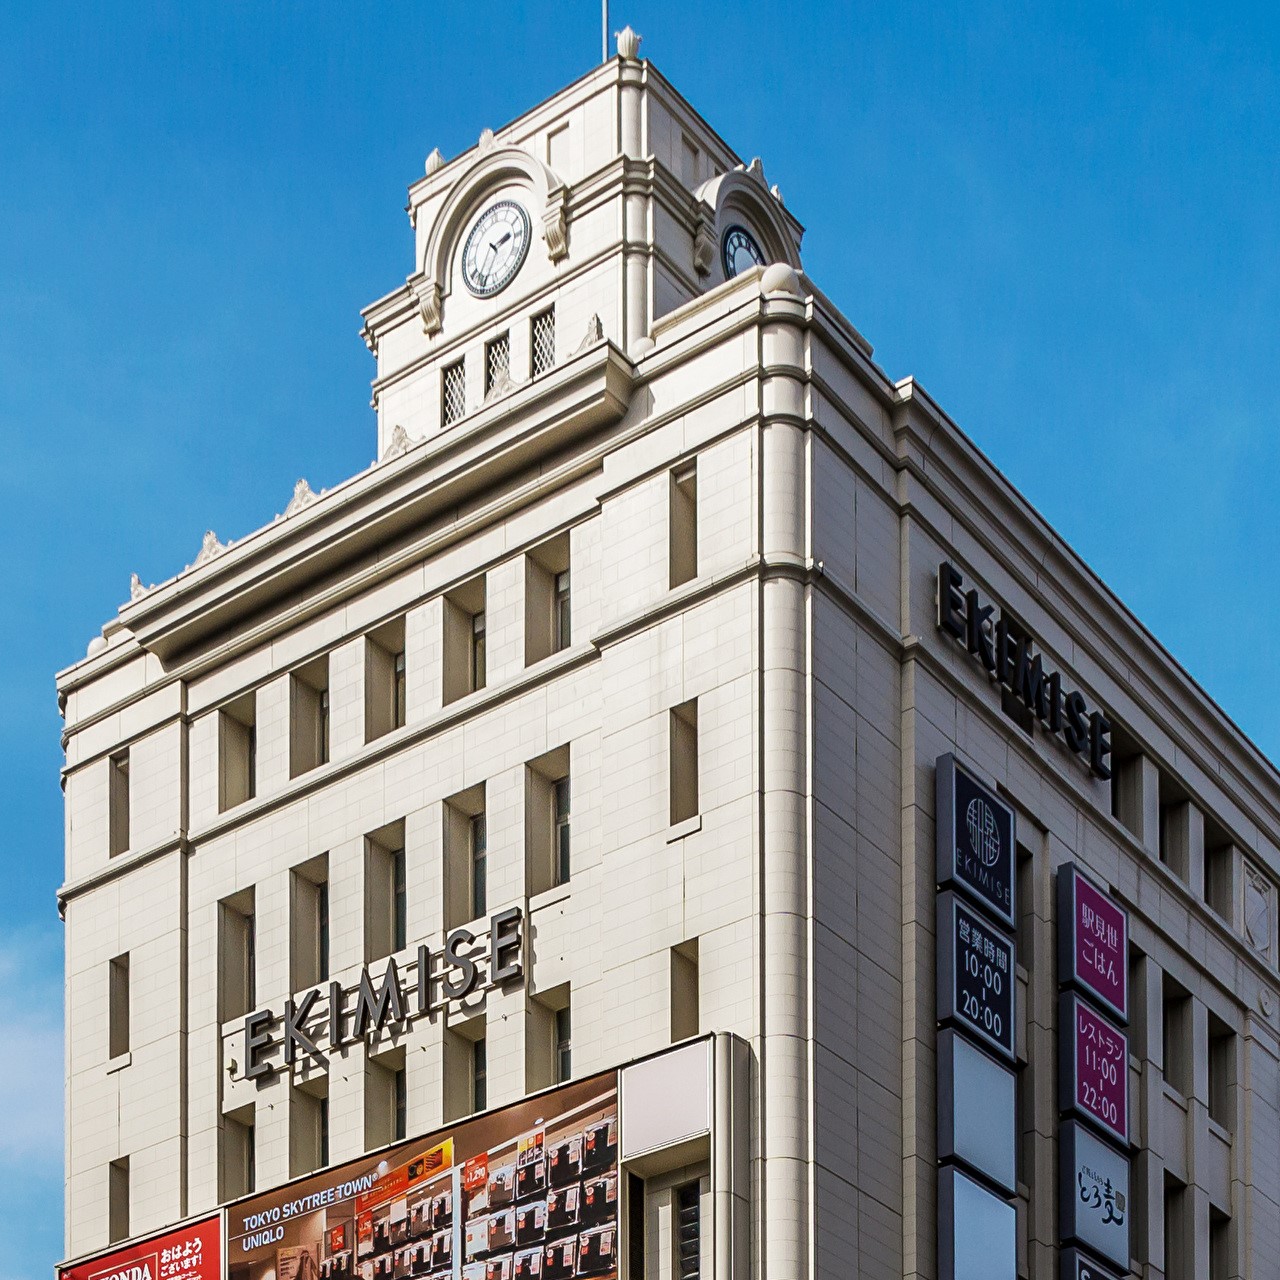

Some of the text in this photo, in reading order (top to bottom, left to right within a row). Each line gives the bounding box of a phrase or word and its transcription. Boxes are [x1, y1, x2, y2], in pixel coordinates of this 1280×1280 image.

[937, 561, 1113, 781] EKIMISE
[956, 847, 1010, 906] EKIMISE
[959, 918, 1008, 973] 営業時間
[1082, 903, 1118, 953] 駅見世
[964, 950, 1002, 995] 10:00
[1082, 938, 1118, 987] ごはん
[244, 906, 526, 1081] EKIMISE
[962, 990, 1002, 1037] 20:00
[1079, 1014, 1123, 1060] レストラン
[1085, 1045, 1117, 1086] 11:00
[1082, 1081, 1117, 1125] 22:00
[243, 1208, 280, 1231] TOKYO
[282, 1188, 335, 1218] SKYTREE
[161, 1237, 202, 1264] おはよう
[242, 1226, 284, 1252] UNIQLO
